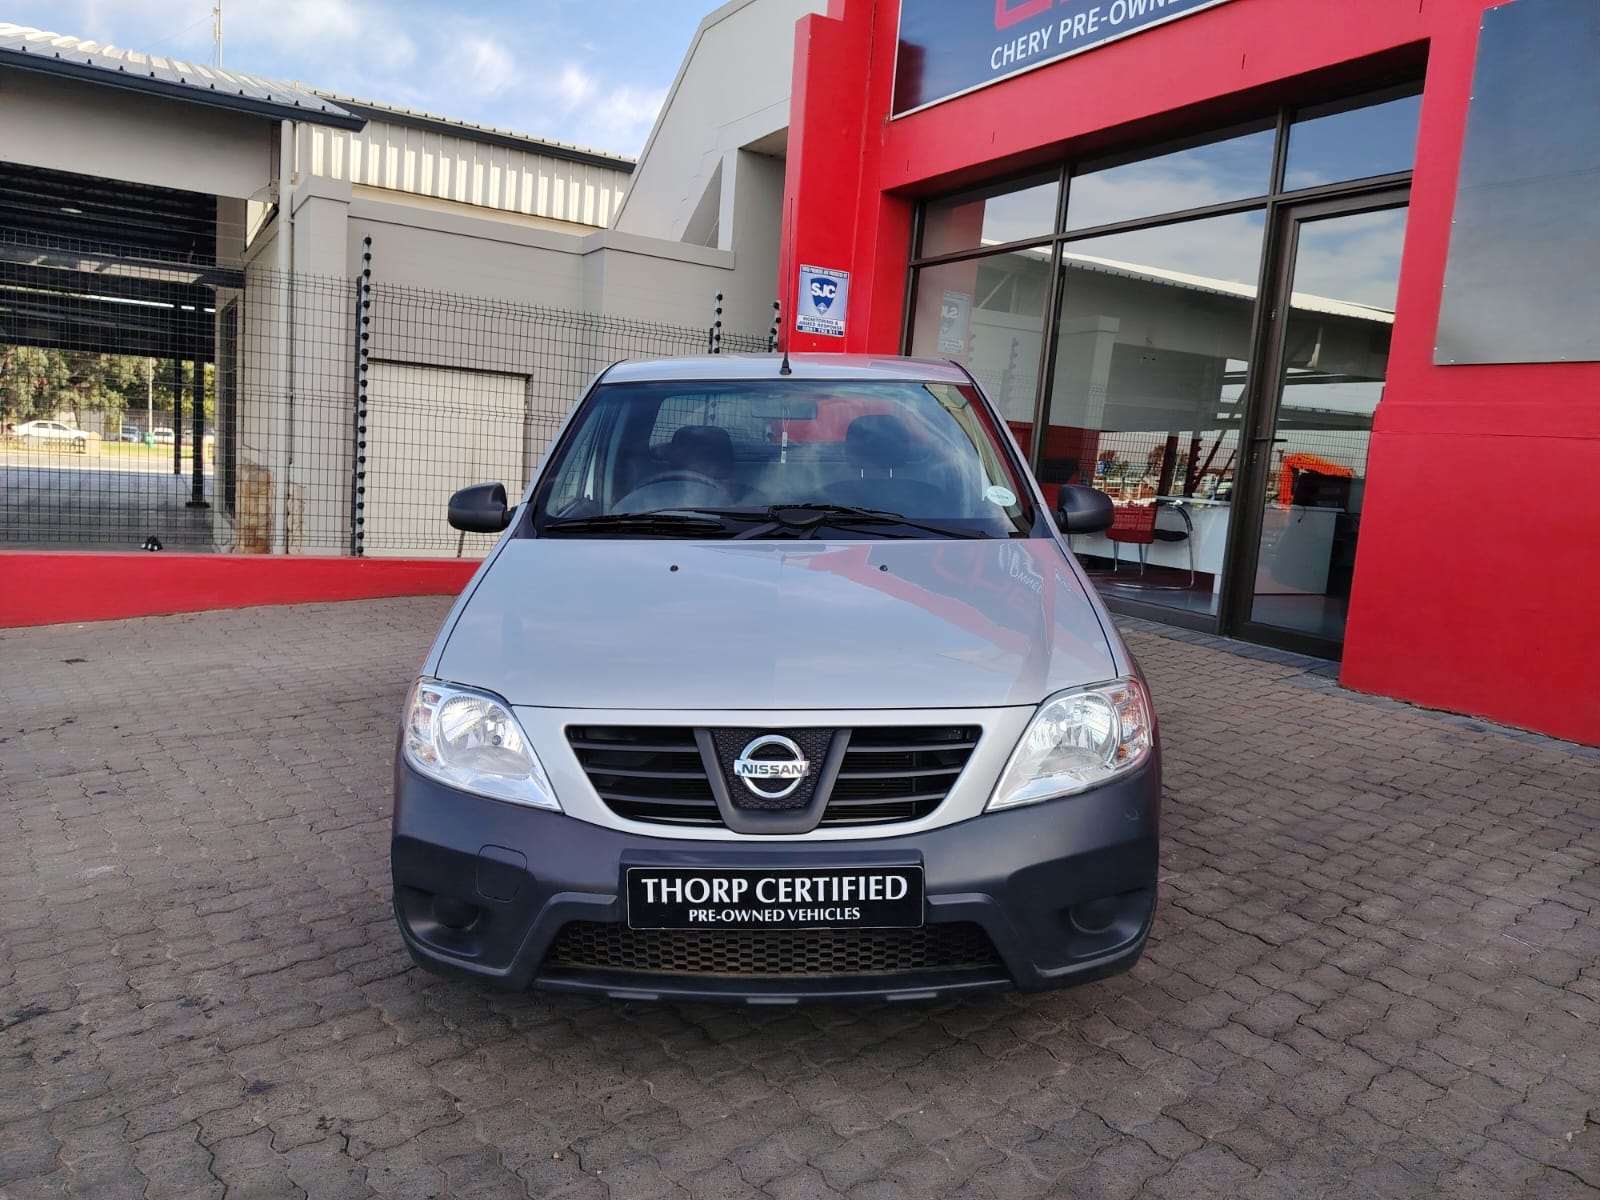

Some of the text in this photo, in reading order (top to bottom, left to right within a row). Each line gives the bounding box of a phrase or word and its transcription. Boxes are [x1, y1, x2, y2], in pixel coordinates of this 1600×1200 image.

[991, 24, 1053, 70] CHERY
[1058, 0, 1180, 44] PRE-OW
[811, 282, 836, 298] SJC
[741, 763, 803, 775] NISSAN
[641, 875, 908, 904] THORP CERTIFIED
[688, 907, 861, 922] PRE-OWNED VEHICLES
